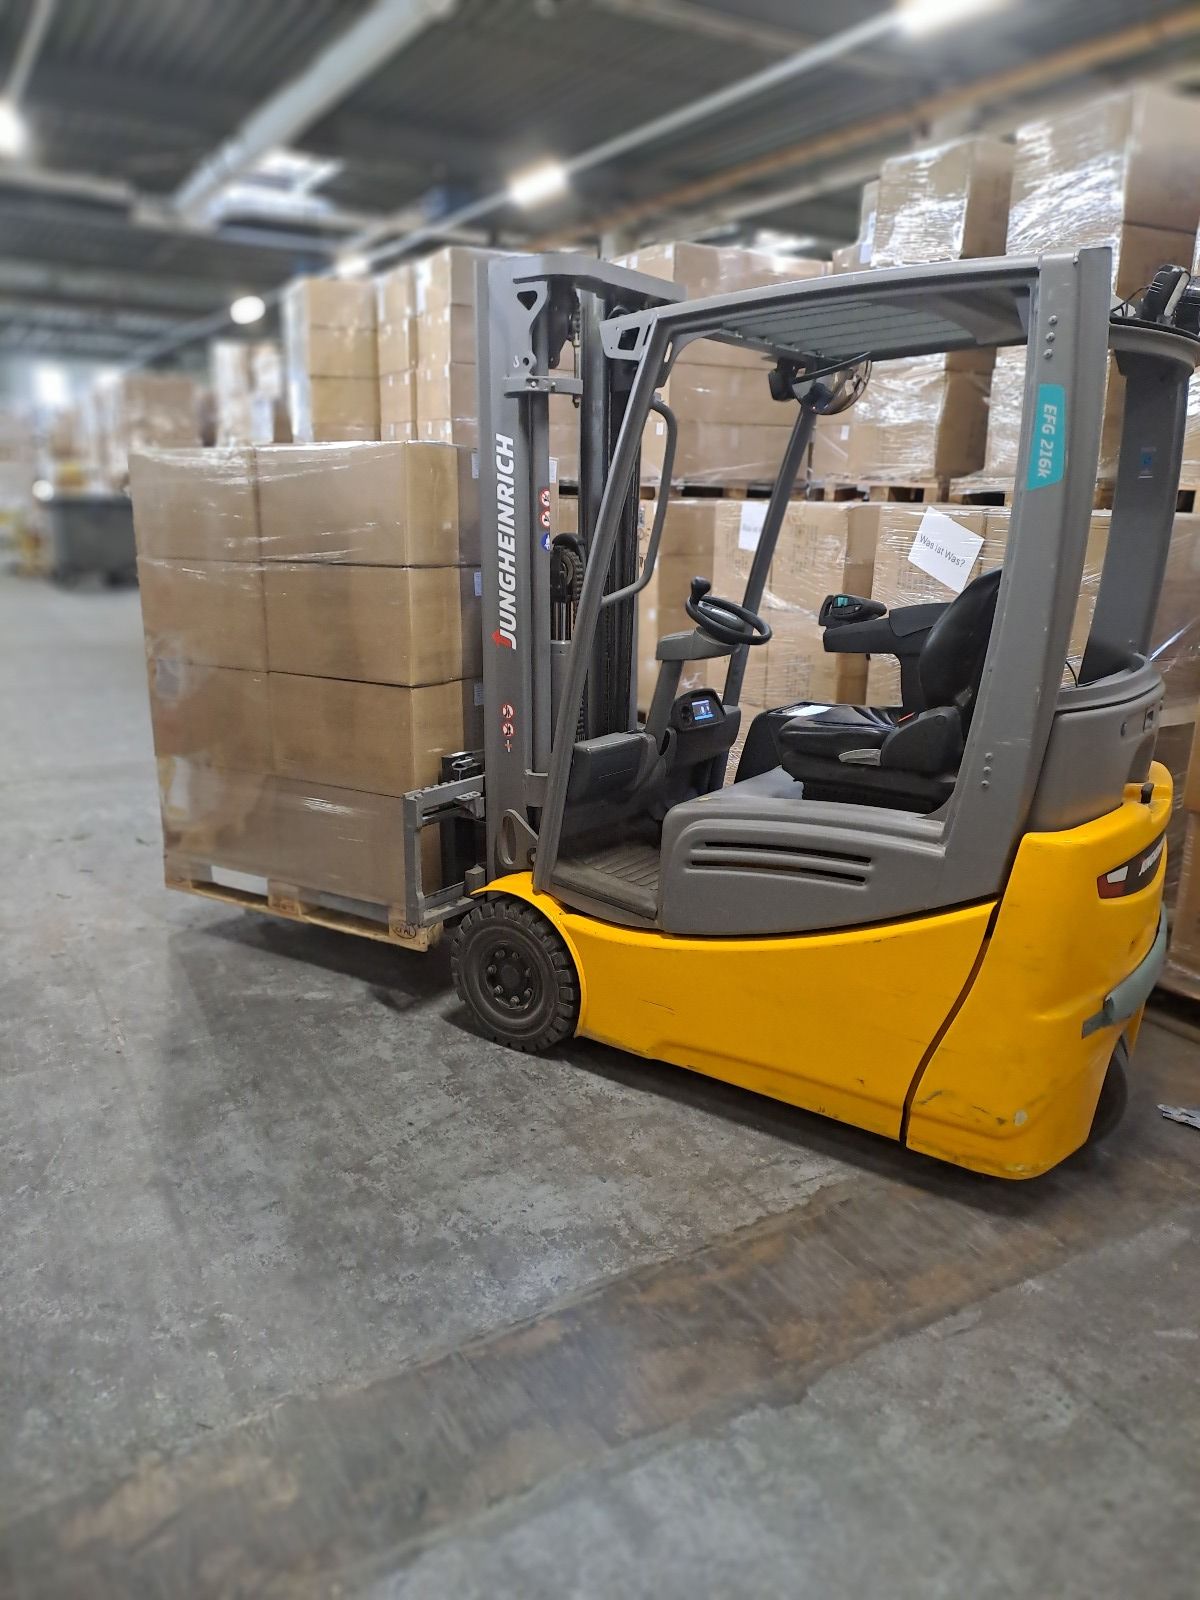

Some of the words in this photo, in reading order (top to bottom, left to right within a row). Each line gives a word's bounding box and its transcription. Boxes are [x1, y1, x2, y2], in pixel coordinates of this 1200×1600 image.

[1042, 404, 1057, 435] EFG
[1037, 439, 1054, 478] 216k
[493, 433, 516, 650] JUNGHEINRICH
[920, 534, 934, 549] Was
[934, 544, 944, 556] ist
[945, 550, 966, 568] Was?
